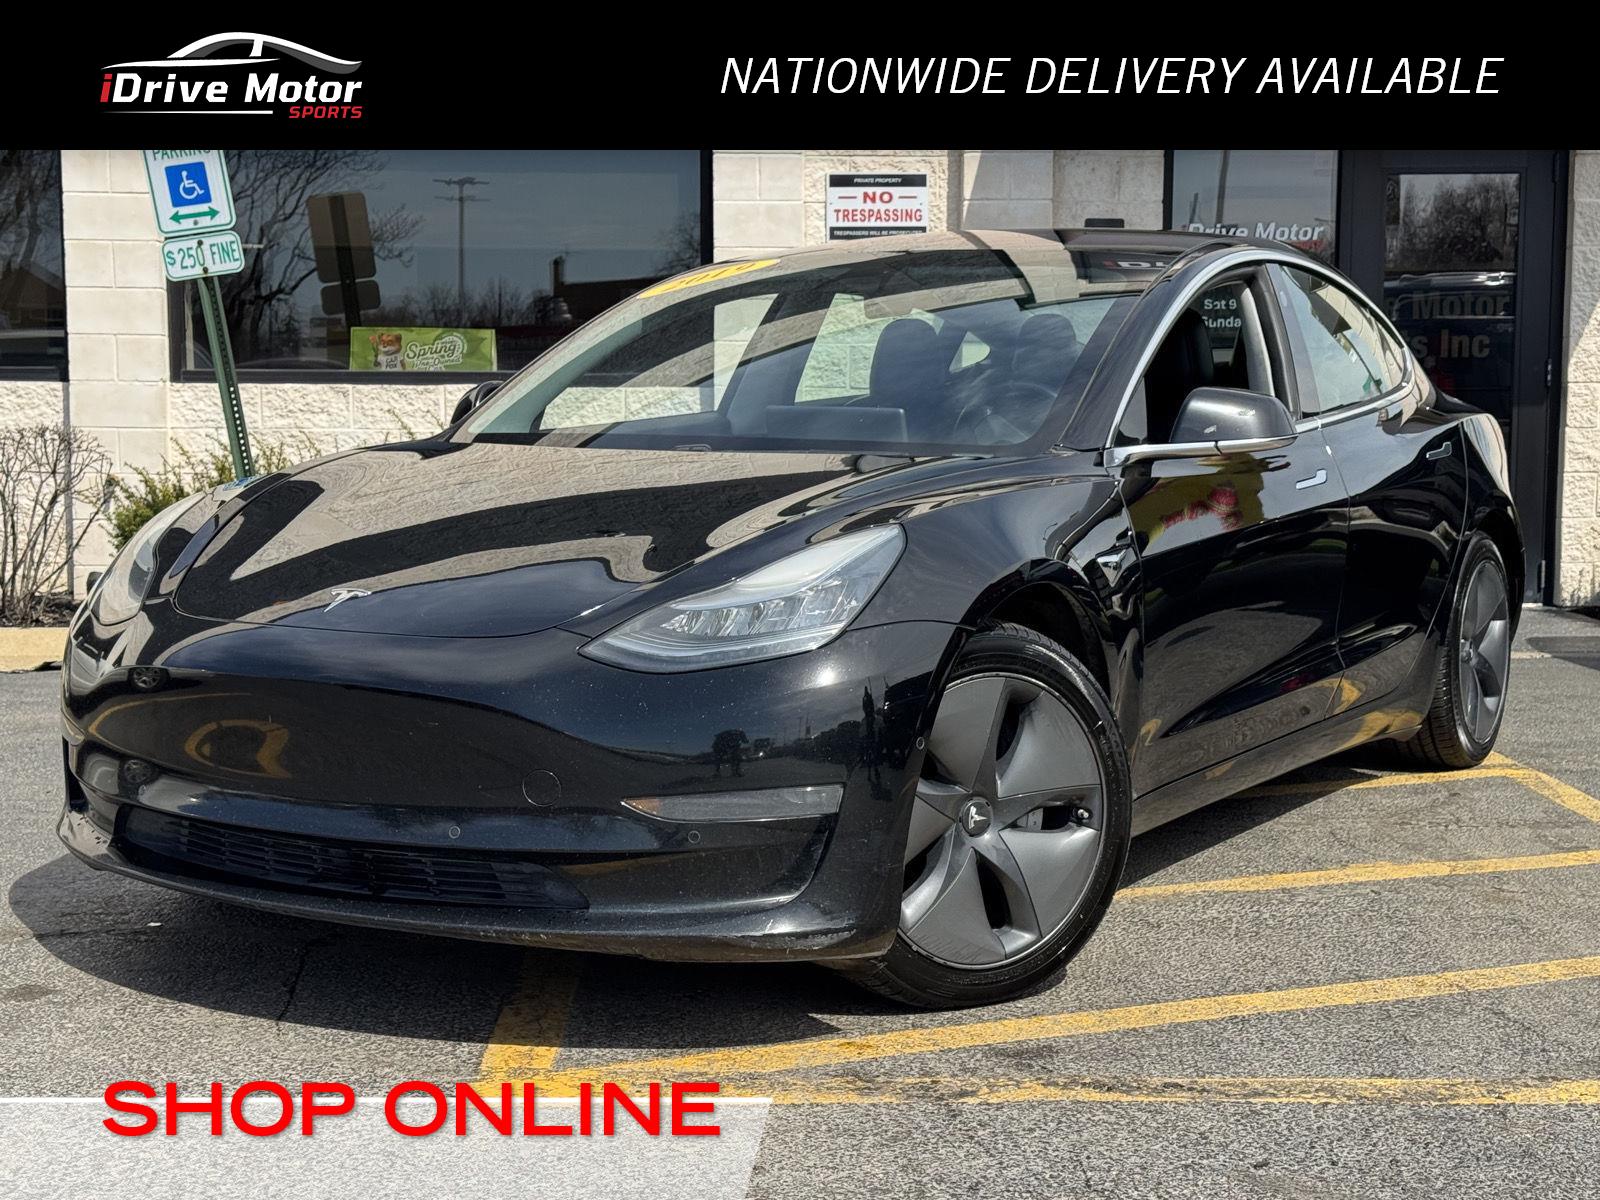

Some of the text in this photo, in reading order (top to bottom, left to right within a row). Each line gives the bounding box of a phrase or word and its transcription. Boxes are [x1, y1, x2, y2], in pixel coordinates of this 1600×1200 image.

[152, 149, 211, 161] PARK
[863, 191, 893, 204] NO
[833, 208, 923, 222] TRESPASSING
[1255, 222, 1324, 241] Motor
[165, 240, 240, 270] $250 FINE
[1229, 299, 1237, 310] 9
[1412, 290, 1511, 320] Motor
[406, 342, 457, 360] Spring
[1440, 328, 1490, 359] Inc
